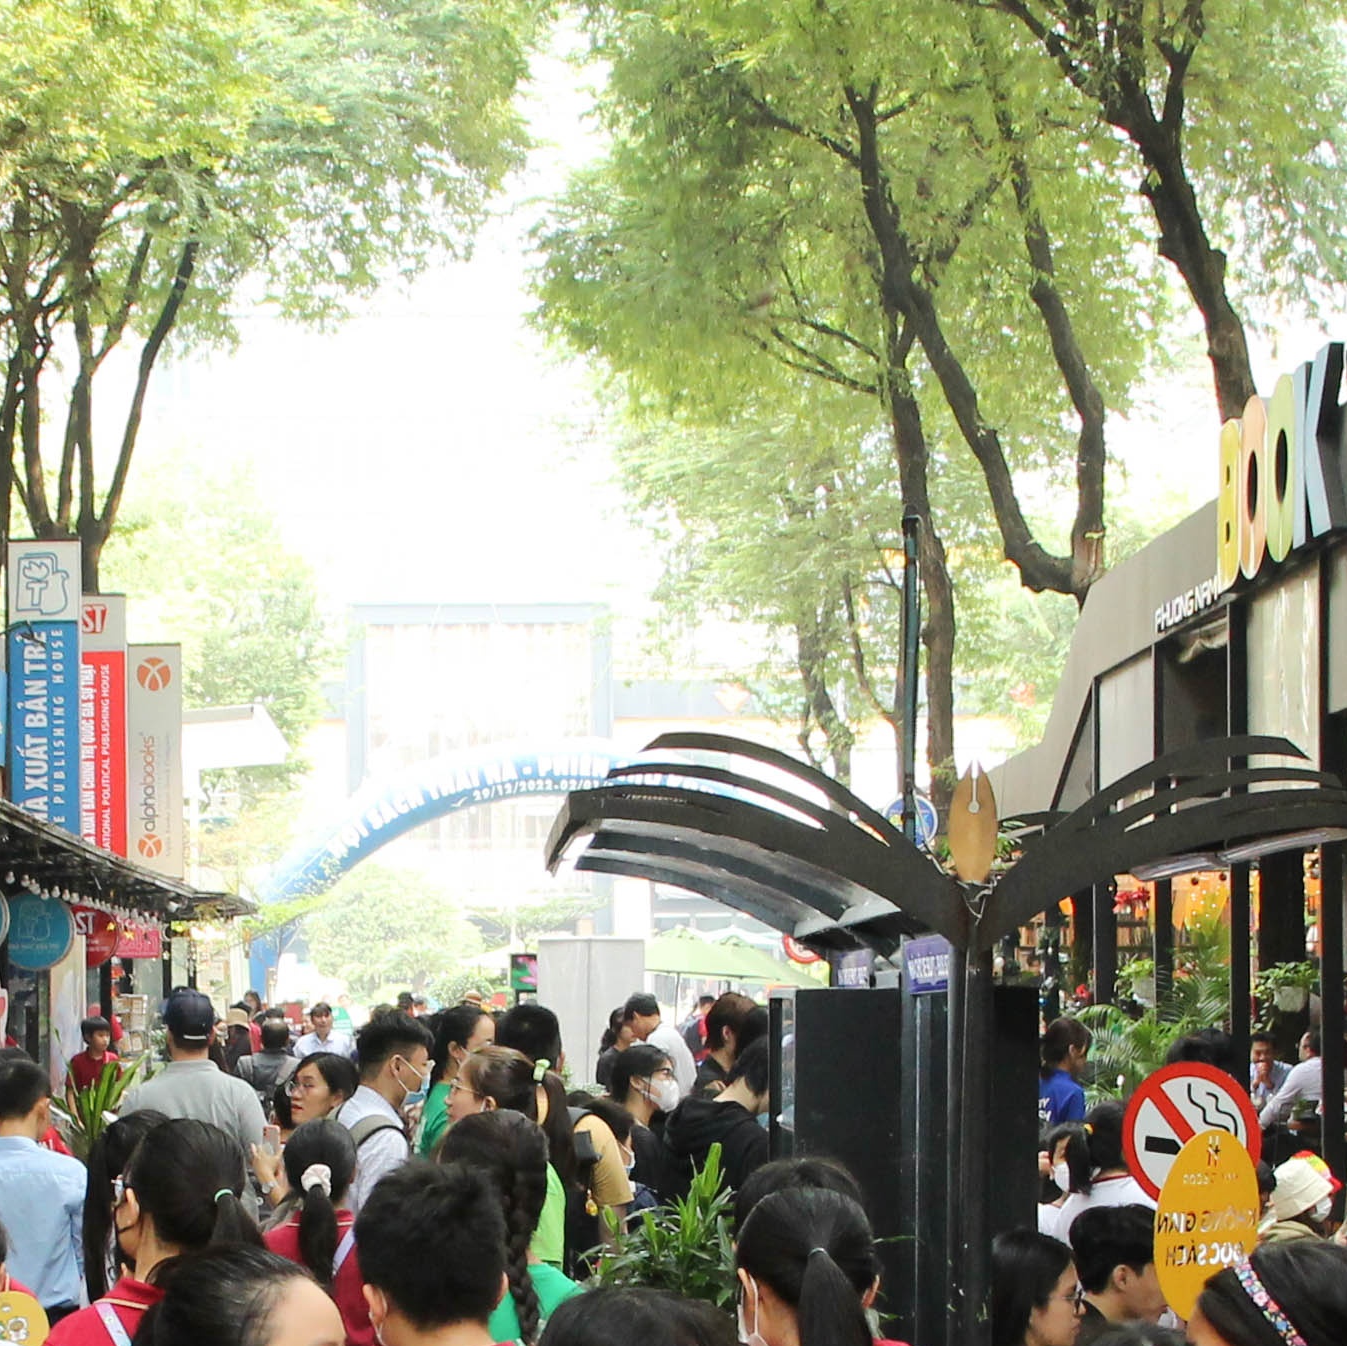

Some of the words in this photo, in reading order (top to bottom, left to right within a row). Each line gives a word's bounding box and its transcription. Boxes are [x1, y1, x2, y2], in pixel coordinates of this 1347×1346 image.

[1217, 342, 1336, 594] BOOK
[51, 629, 65, 684] HOUSE
[100, 664, 111, 696] HOUSE
[52, 696, 65, 804] PUBLISHING
[100, 699, 111, 755] PUBLISHING
[100, 758, 111, 805] POLITICAL
[139, 735, 157, 832] alphabooks
